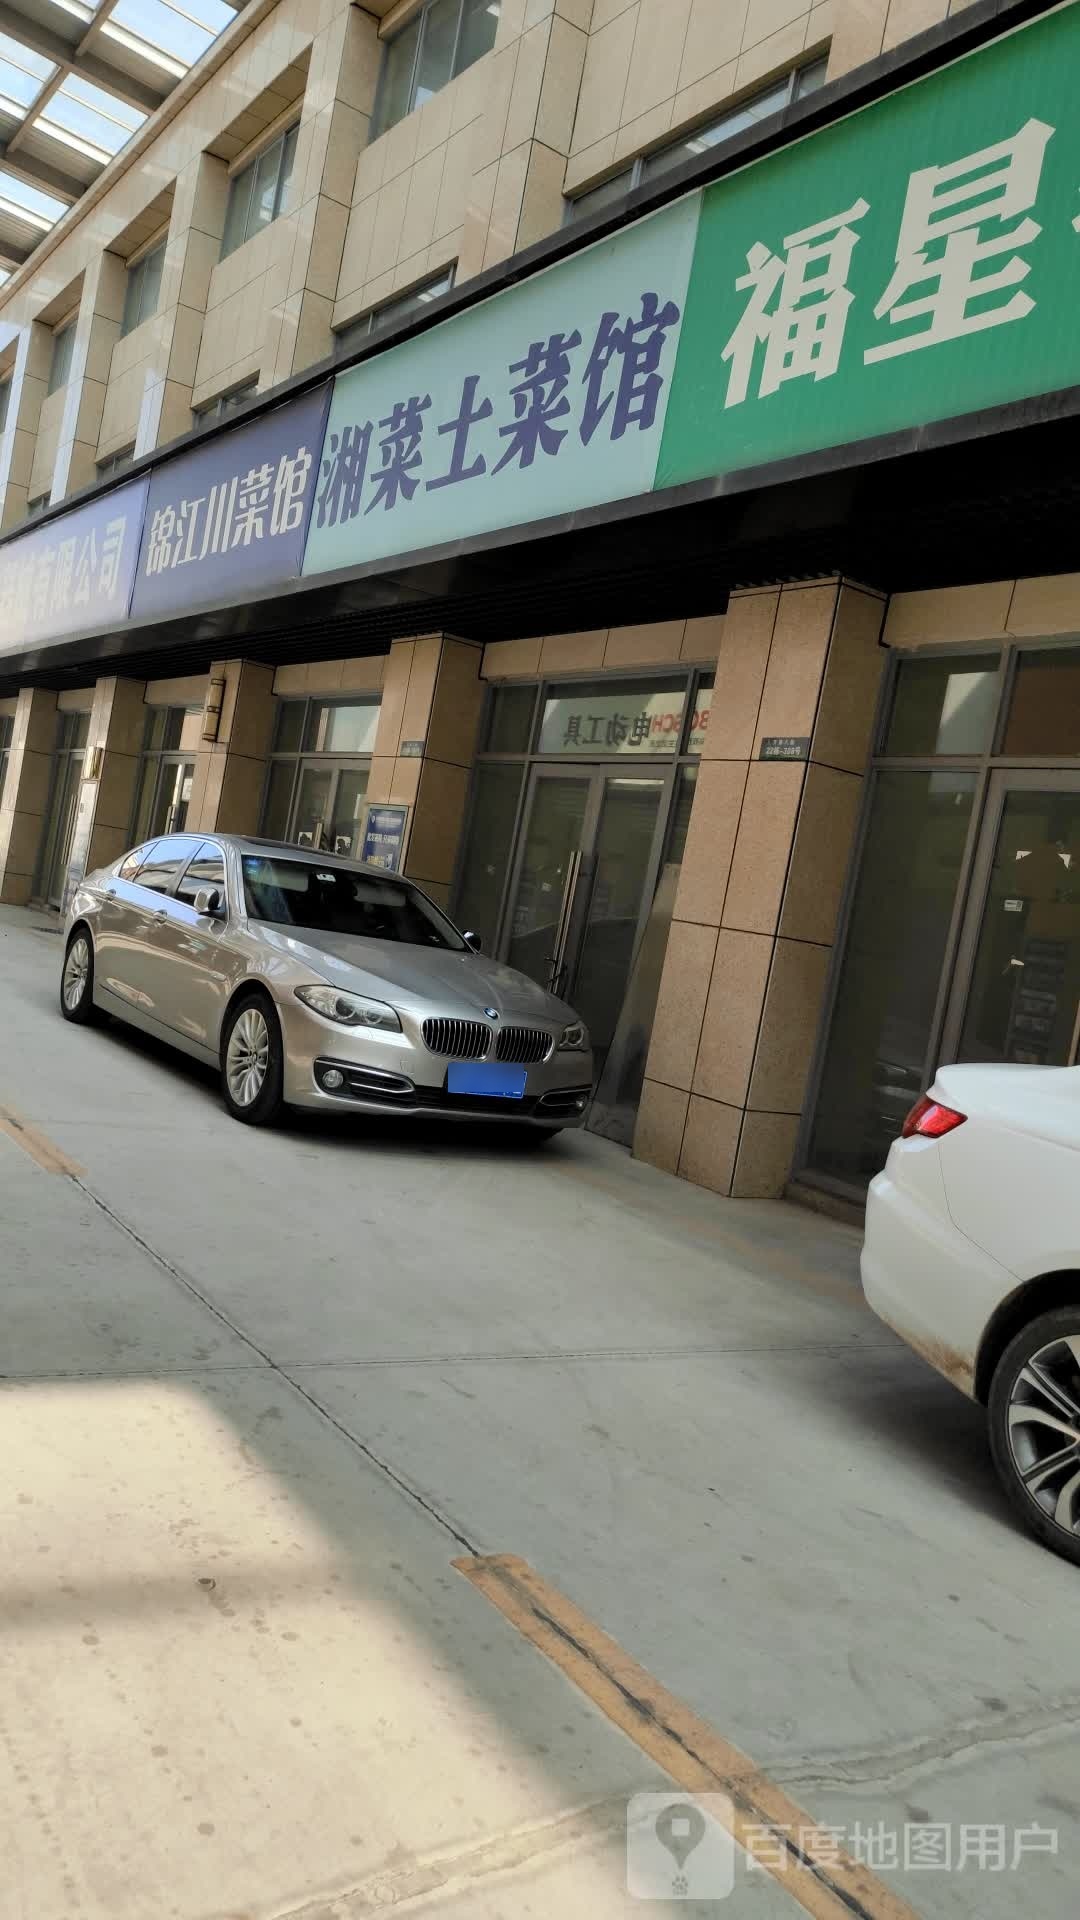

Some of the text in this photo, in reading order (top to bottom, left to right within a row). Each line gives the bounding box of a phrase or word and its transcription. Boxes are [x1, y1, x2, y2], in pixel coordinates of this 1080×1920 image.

[720, 117, 1080, 409] 福星
[316, 292, 680, 528] 湘菜土菜馆
[0, 514, 127, 623] 有限公司
[145, 447, 312, 577] 锦江川菜馆
